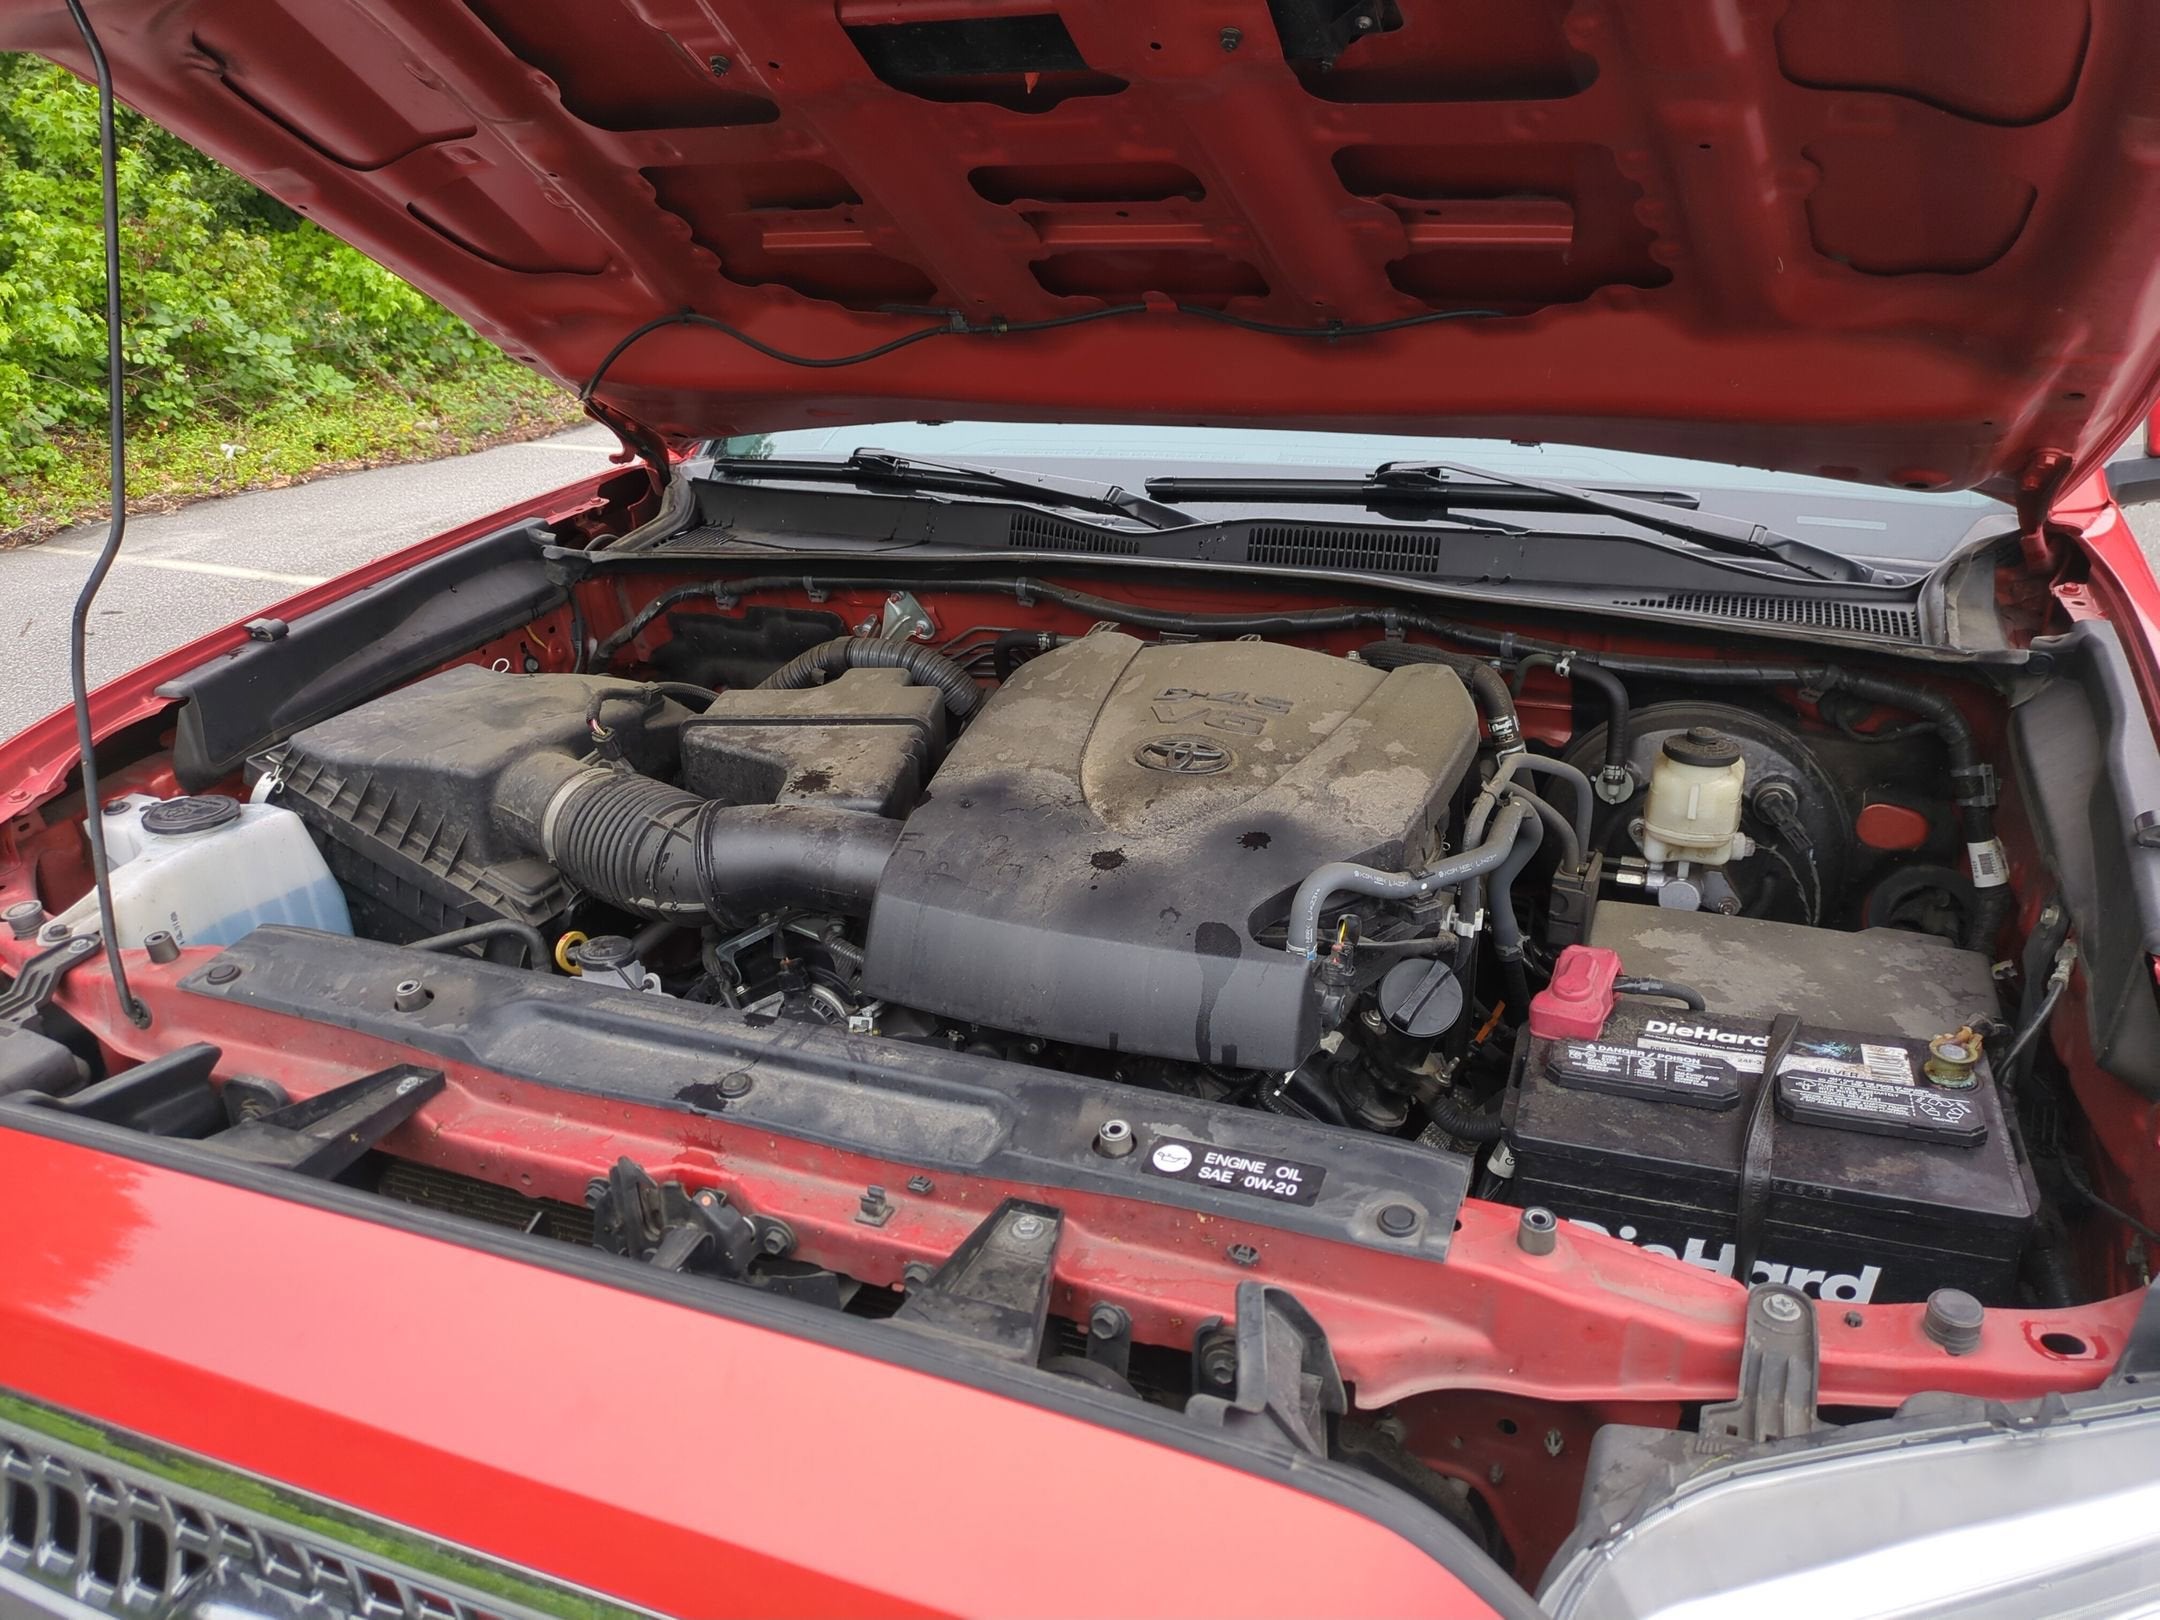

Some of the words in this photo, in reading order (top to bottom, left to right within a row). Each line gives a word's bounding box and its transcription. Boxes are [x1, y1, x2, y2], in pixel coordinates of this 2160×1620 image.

[1645, 1019, 1770, 1047] DieHard
[1598, 1045, 1646, 1057] DANGER
[1657, 1053, 1701, 1064] POISON
[1815, 1067, 1858, 1078] SILVER
[1198, 1166, 1235, 1184] SAE
[1243, 1175, 1298, 1196] 0W-20
[1204, 1152, 1267, 1173] ENGINE
[1275, 1166, 1303, 1182] OIL
[1569, 1219, 1883, 1304] Hard
